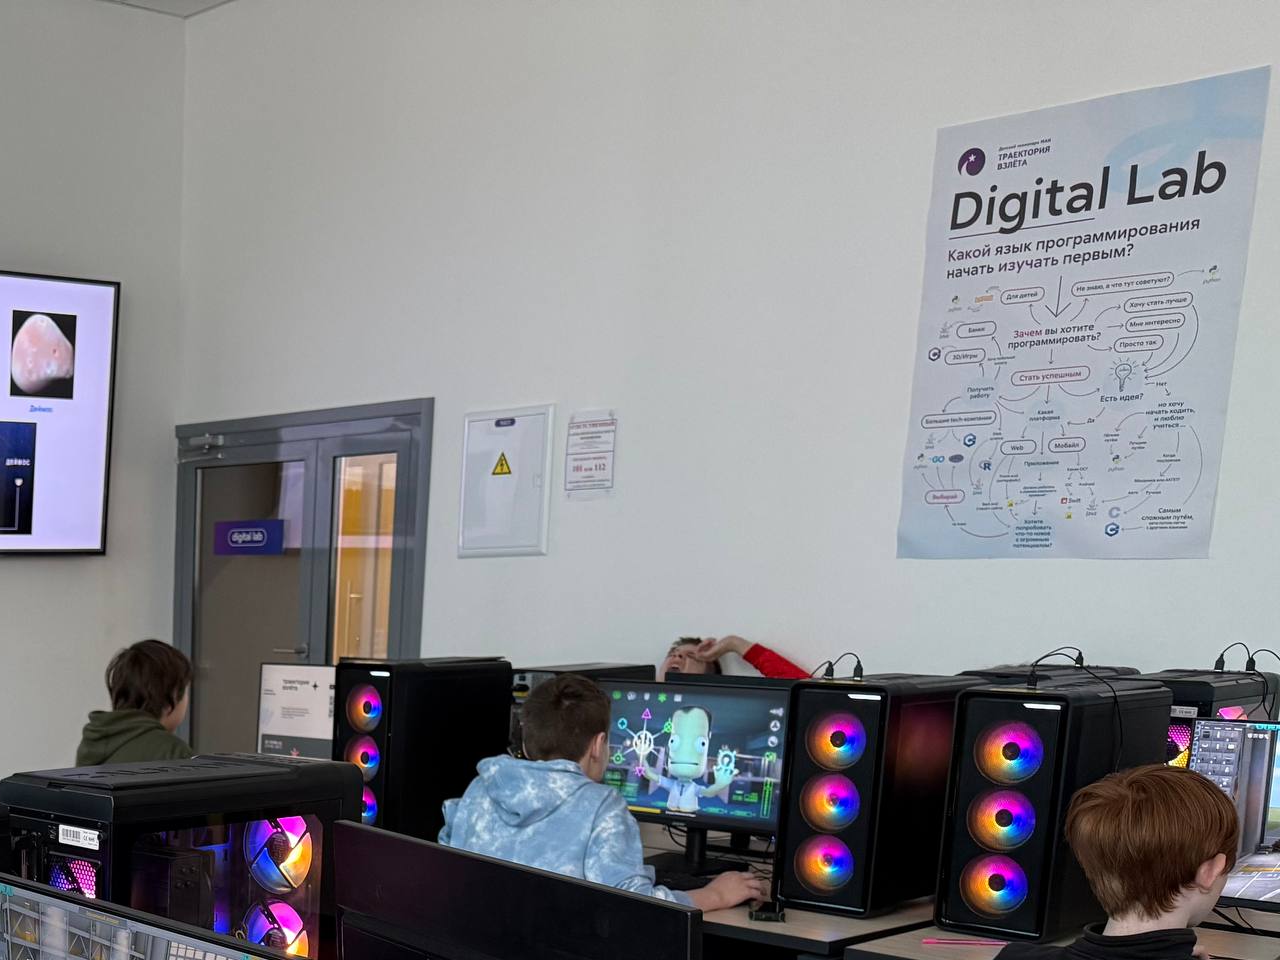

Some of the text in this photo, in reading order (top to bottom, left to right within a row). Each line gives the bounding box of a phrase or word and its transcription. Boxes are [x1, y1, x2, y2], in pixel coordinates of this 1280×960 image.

[998, 145, 1051, 161] ТРАЕКТОРИЯ
[997, 159, 1027, 170] ВЗЛЁТА
[949, 150, 1227, 235] Digital Lab
[948, 219, 1201, 262] Какой язык программирования
[946, 243, 1134, 279] начать изучать первым?
[1013, 322, 1095, 339] Зачем вы хотите
[1007, 331, 1102, 350] программировать?
[1100, 395, 1118, 403] Есть
